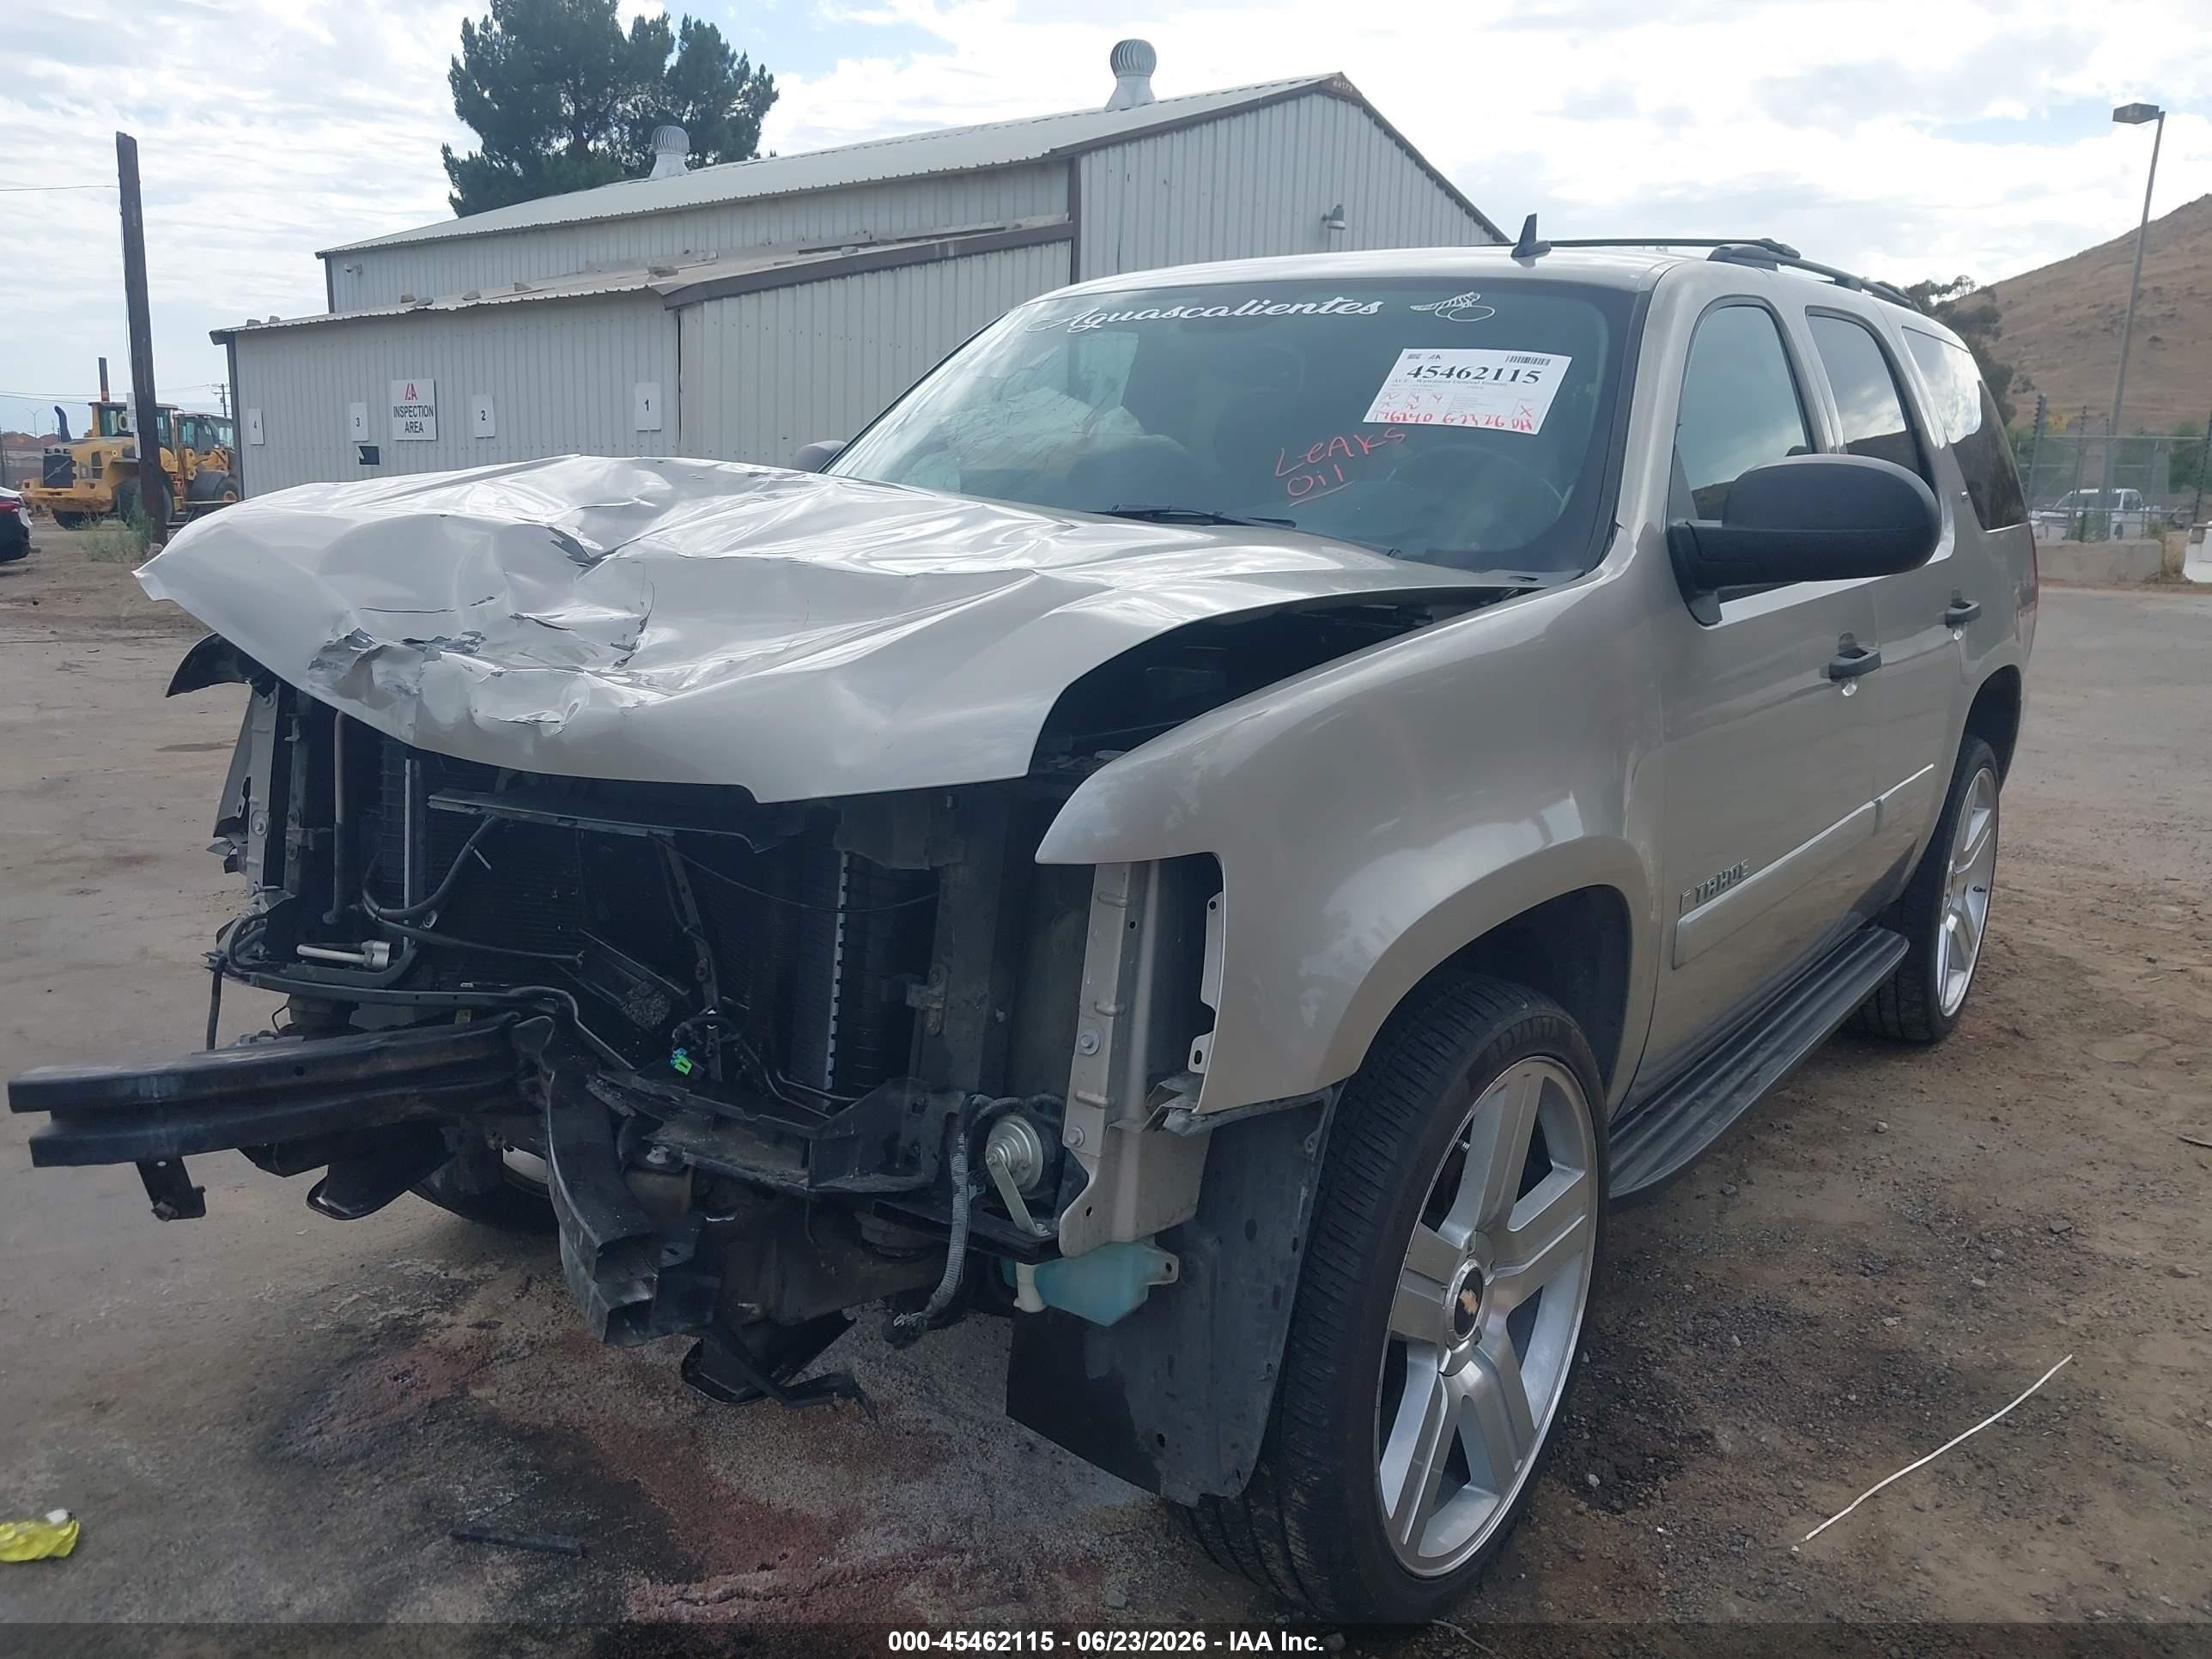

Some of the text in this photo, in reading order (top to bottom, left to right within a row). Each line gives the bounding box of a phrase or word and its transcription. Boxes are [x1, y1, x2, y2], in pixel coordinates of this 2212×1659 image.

[1025, 296, 1384, 333] Aguascalientes
[1407, 365, 1542, 385] 45462115
[393, 404, 434, 418] INSPECTION
[645, 398, 650, 411] 1
[355, 417, 361, 428] 3
[480, 410, 487, 422] 2
[404, 421, 424, 434] AREA
[1694, 859, 1749, 904] TAHOE
